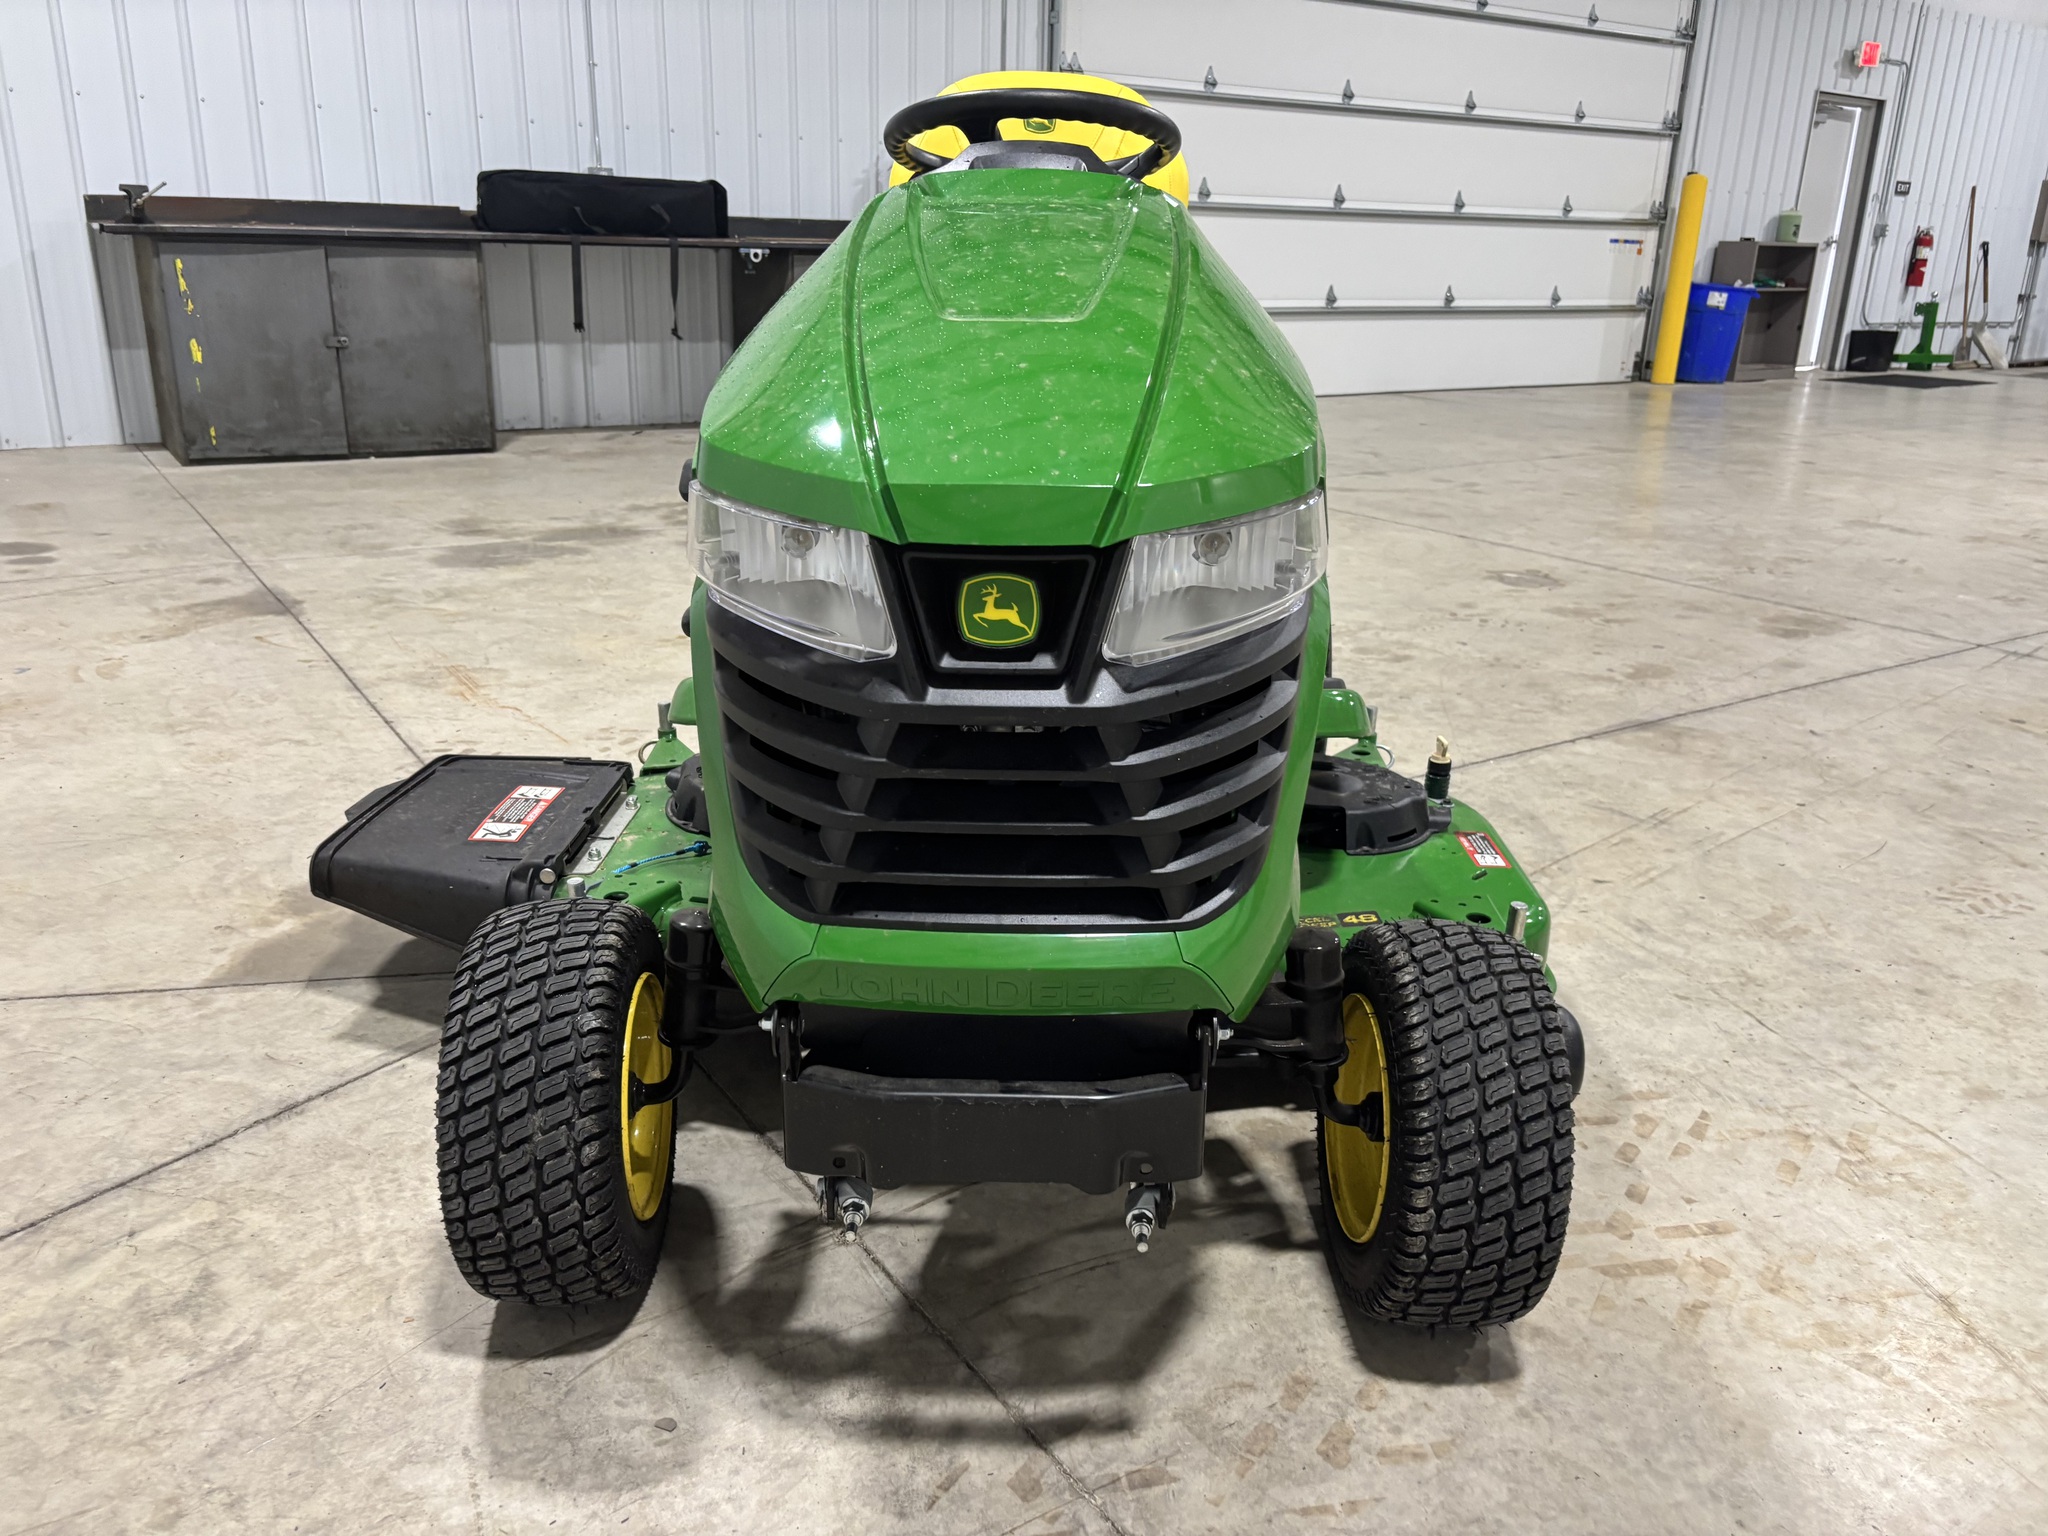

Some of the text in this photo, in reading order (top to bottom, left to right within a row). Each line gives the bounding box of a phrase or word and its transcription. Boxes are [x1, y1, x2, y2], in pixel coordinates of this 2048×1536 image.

[1897, 183, 1909, 192] EXIT
[1343, 913, 1378, 923] 48
[819, 966, 1176, 1008] JOHN DEERE
